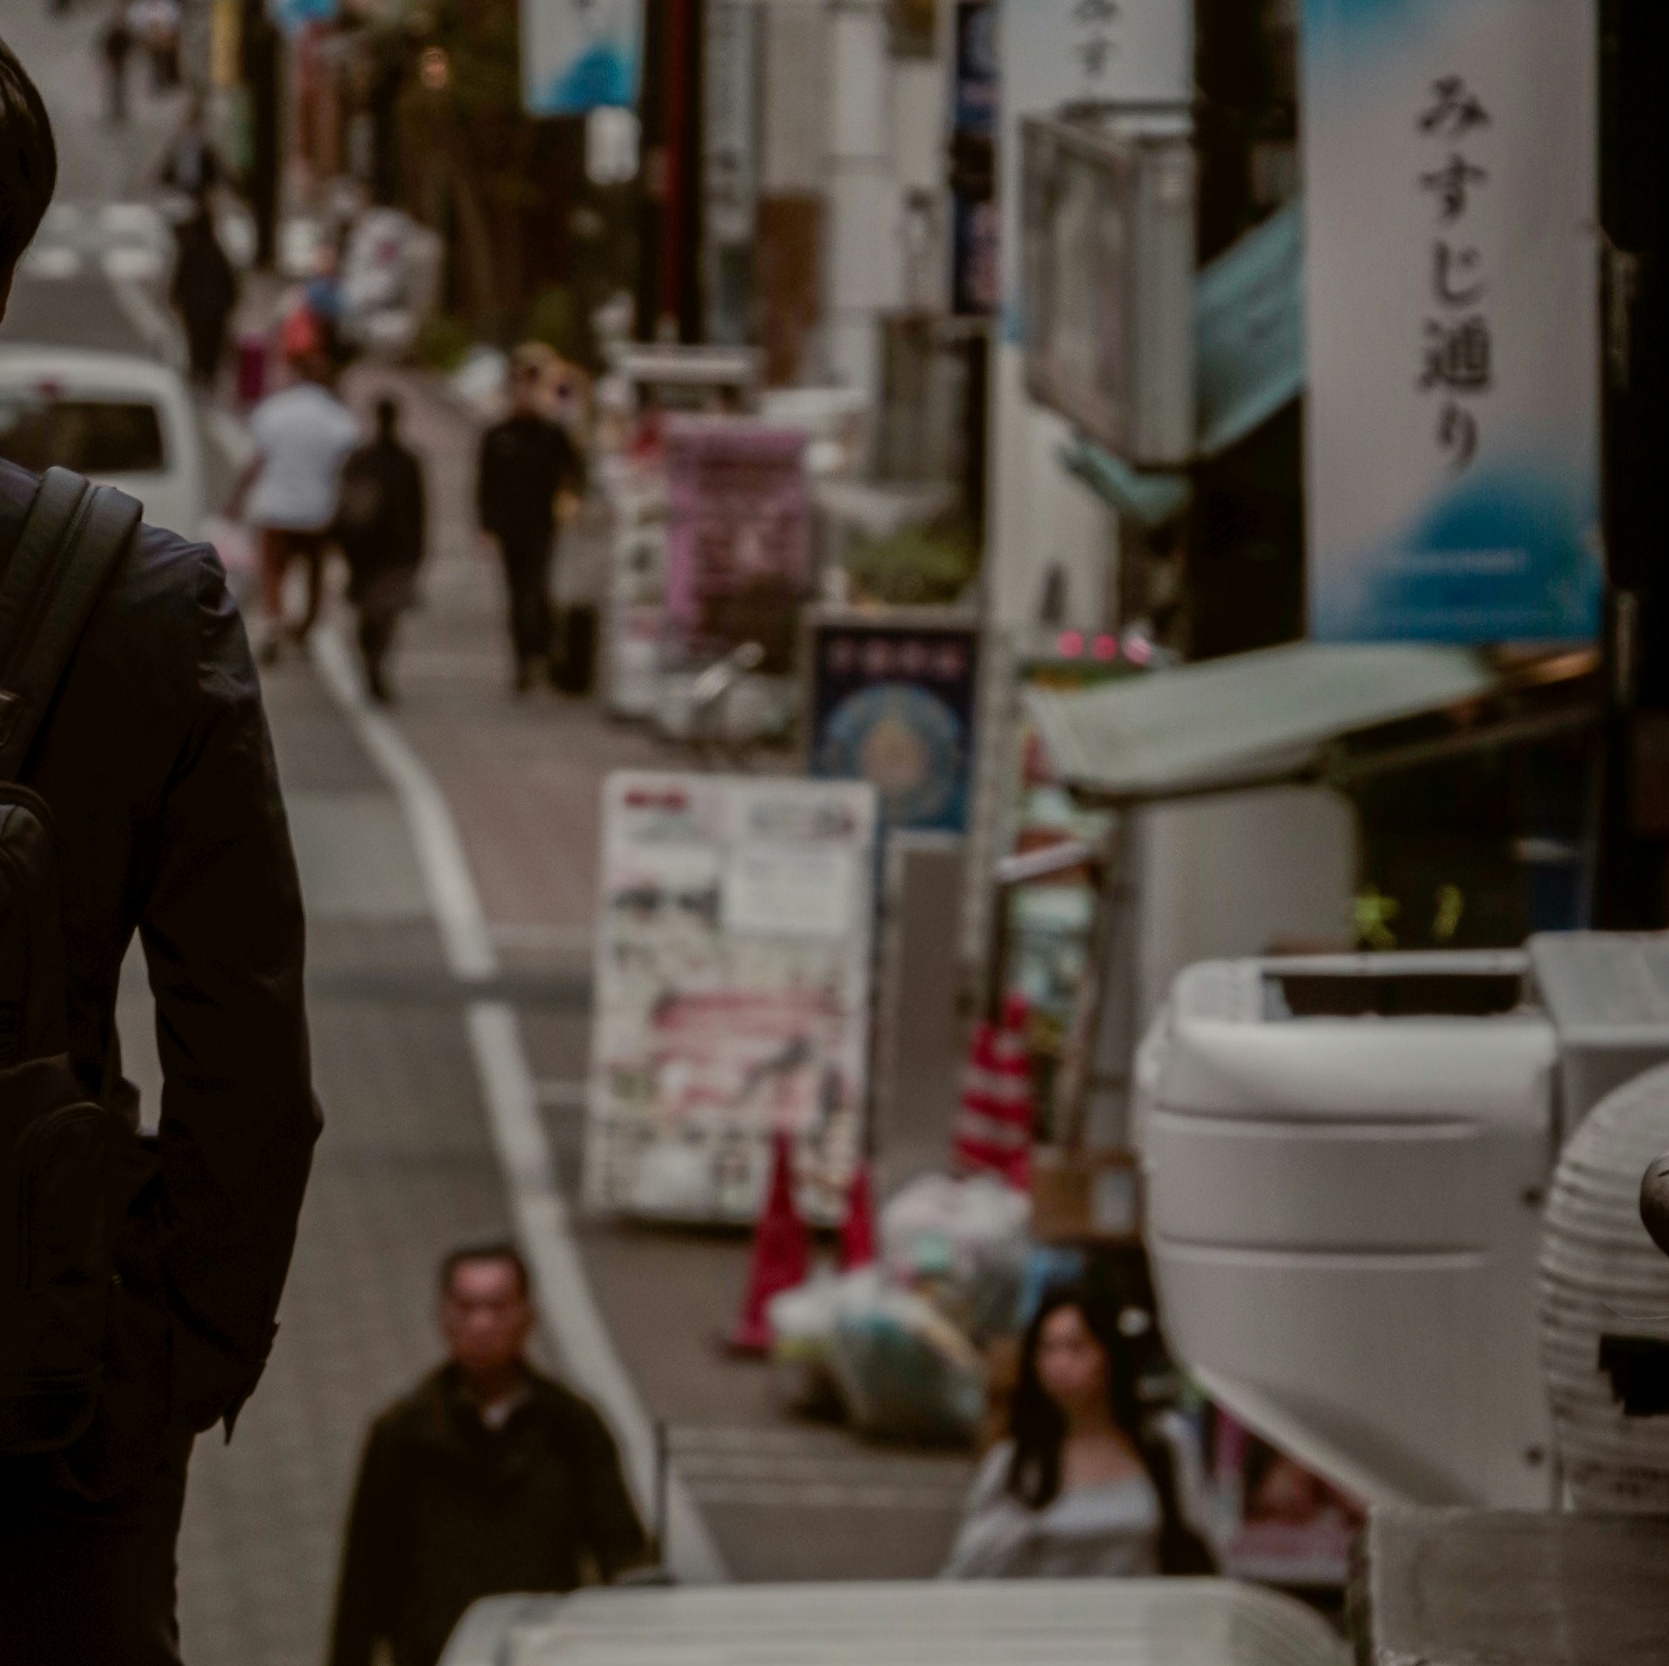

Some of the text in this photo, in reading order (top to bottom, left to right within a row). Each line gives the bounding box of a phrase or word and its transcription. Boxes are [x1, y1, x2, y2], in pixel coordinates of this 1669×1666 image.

[1418, 74, 1495, 475] みすじ通り
